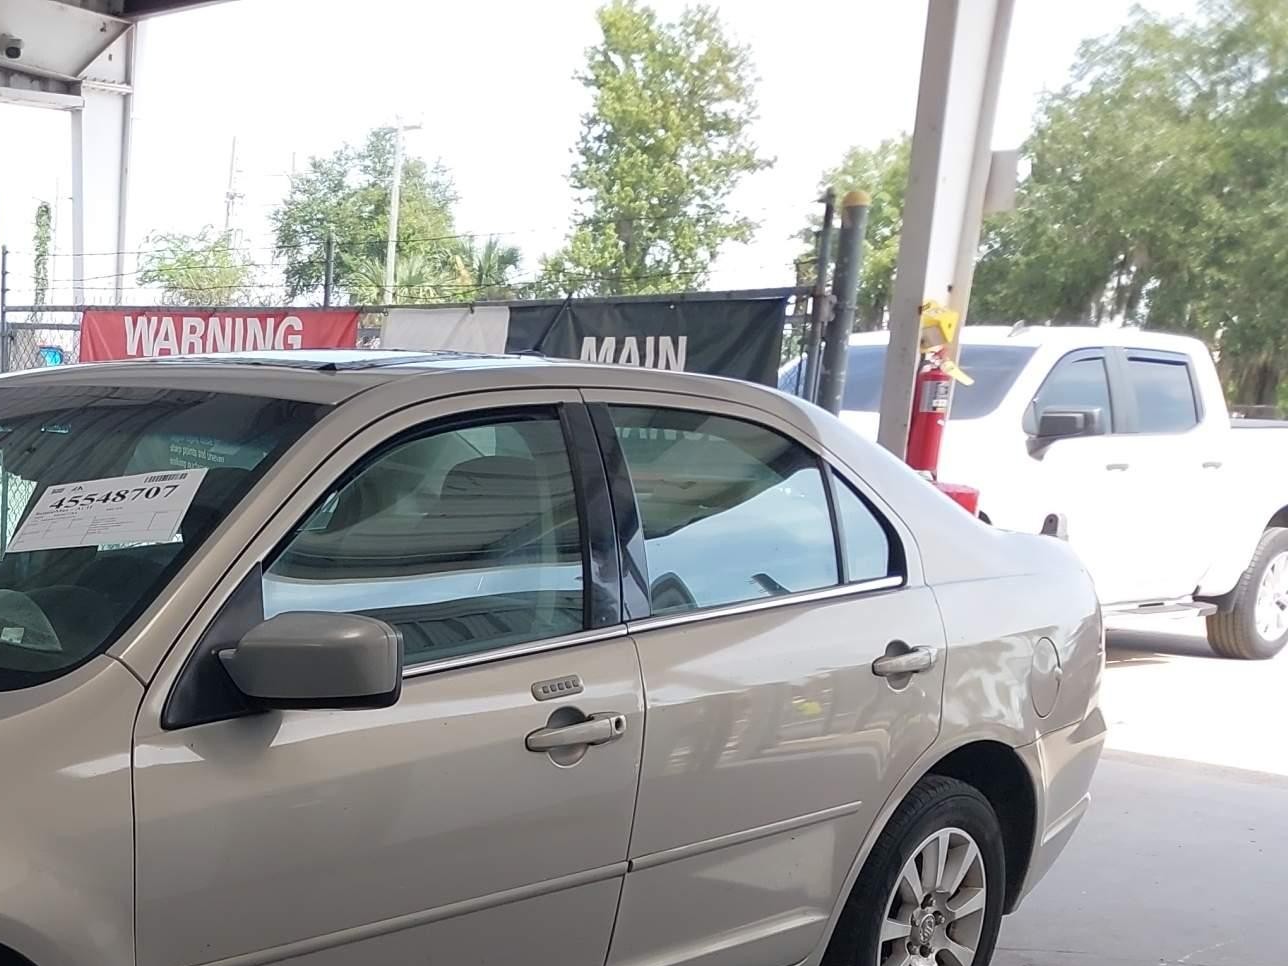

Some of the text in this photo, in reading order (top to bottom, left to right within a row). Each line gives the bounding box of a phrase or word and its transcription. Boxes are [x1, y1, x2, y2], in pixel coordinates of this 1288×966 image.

[124, 316, 303, 357] WARNING
[580, 336, 687, 373] MAIN
[49, 485, 180, 509] 45548707
